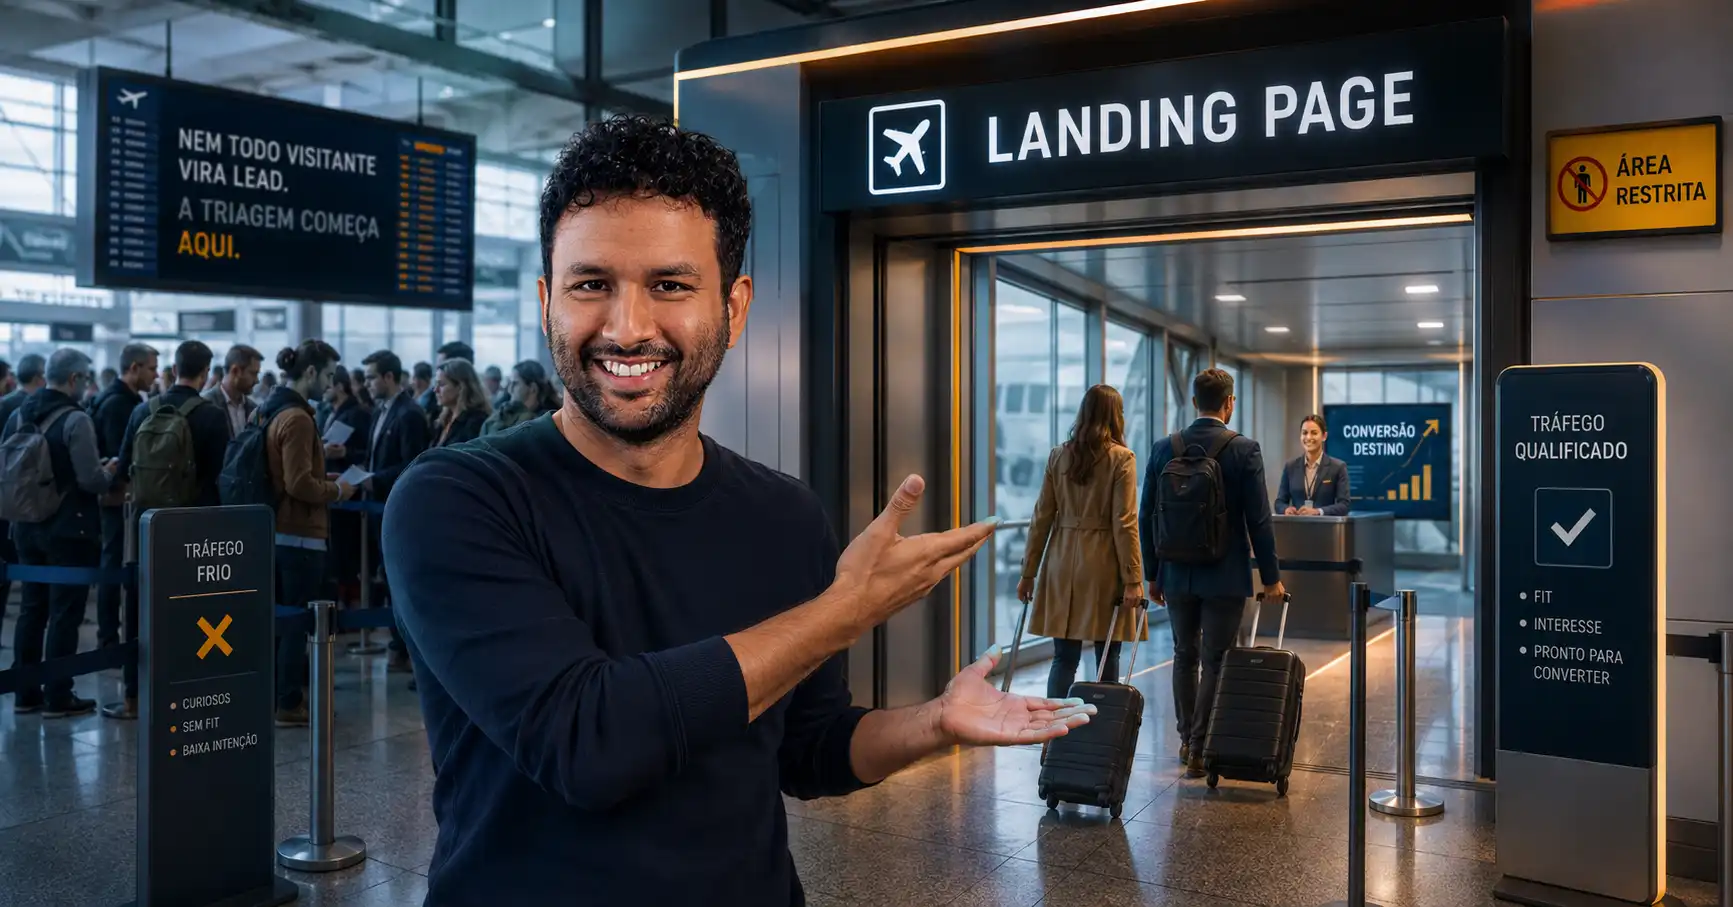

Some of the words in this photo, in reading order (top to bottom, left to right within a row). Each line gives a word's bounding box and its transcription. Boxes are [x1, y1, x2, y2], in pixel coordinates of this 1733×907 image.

[989, 91, 1236, 163] LANDING
[1266, 71, 1413, 137] PAGE
[179, 127, 222, 154] NEM
[228, 135, 281, 162] TODO
[287, 144, 376, 175] VISITANTE
[1617, 153, 1672, 177] ÁREA
[179, 159, 226, 185] VIRA
[234, 166, 288, 192] LEAD.
[1617, 182, 1706, 205] RESTRITA
[177, 196, 195, 221] A
[201, 199, 293, 229] TRIAGEM
[301, 210, 379, 243] COMEÇA
[178, 231, 239, 258] AQUI.
[1344, 422, 1415, 437] CONVERSÃO
[1531, 411, 1604, 431] TRÁFEGO
[1353, 442, 1405, 456] DESTINO
[1516, 442, 1627, 460] QUALIFICADO
[184, 539, 243, 557] TRÁFEGO
[198, 564, 230, 582] FRIO
[1535, 590, 1552, 603] FIT
[1535, 618, 1601, 634] INTERESSE
[1535, 645, 1584, 661] PRONTO
[1590, 649, 1623, 664] PARA
[1534, 666, 1609, 684] CONVERTER
[183, 693, 230, 709] CURIOSOS
[183, 720, 202, 732] SEM
[206, 717, 219, 729] FIT
[183, 742, 210, 756] BAIXA
[213, 733, 257, 750] INTENÇÃO
